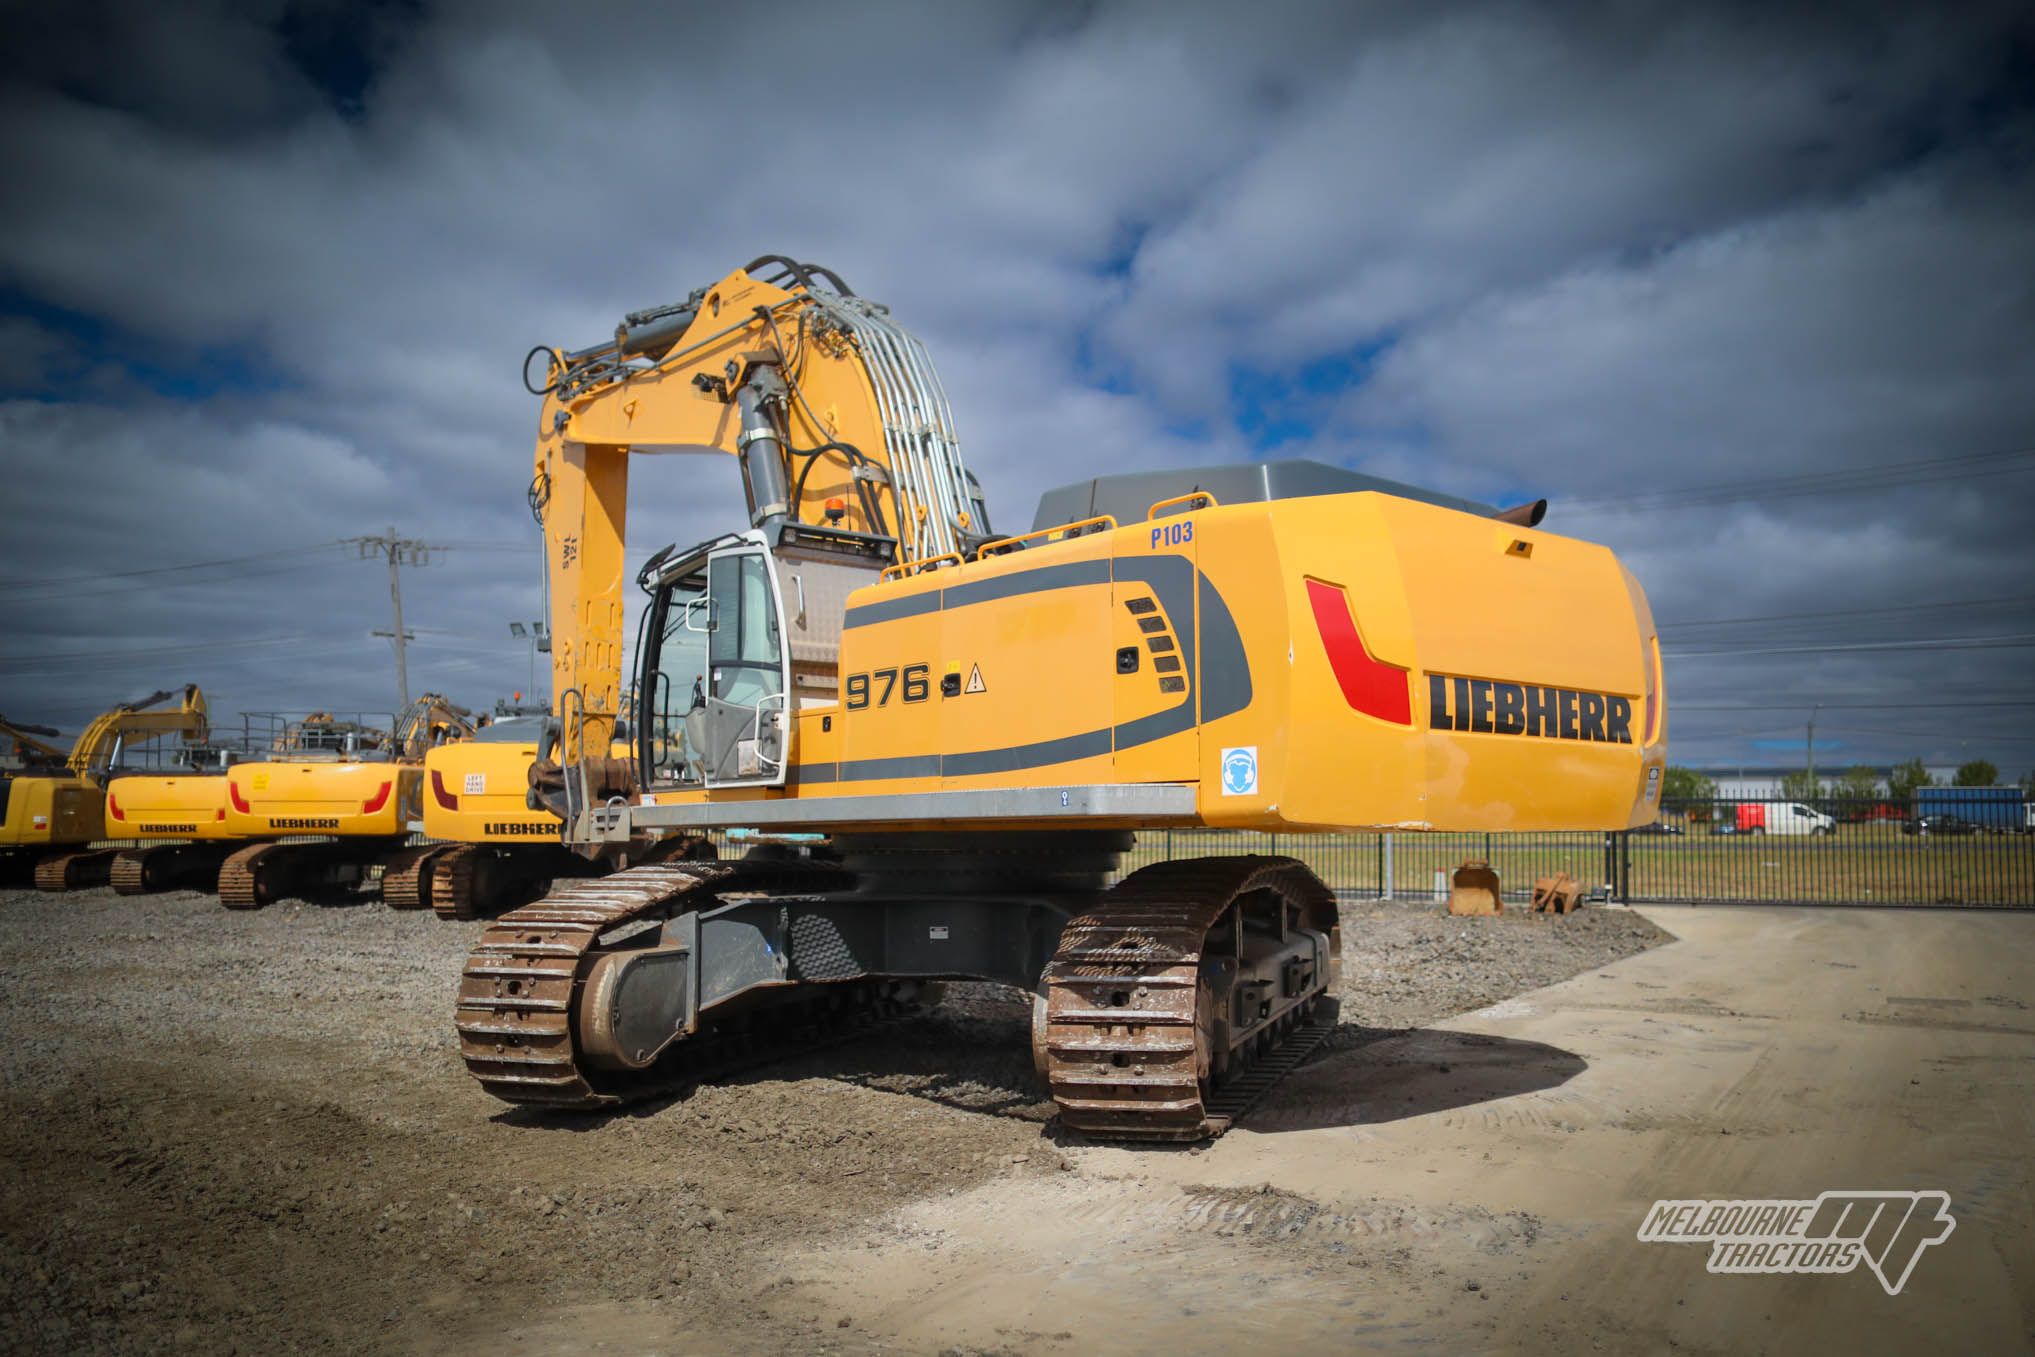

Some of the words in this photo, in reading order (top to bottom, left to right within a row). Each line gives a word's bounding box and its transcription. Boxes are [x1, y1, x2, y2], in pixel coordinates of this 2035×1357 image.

[1150, 520, 1194, 550] P103
[845, 661, 931, 712] 976
[1429, 675, 1633, 745] LIEBHERR
[139, 823, 198, 833] LIEBHERR
[268, 818, 340, 829] LIEBHERR
